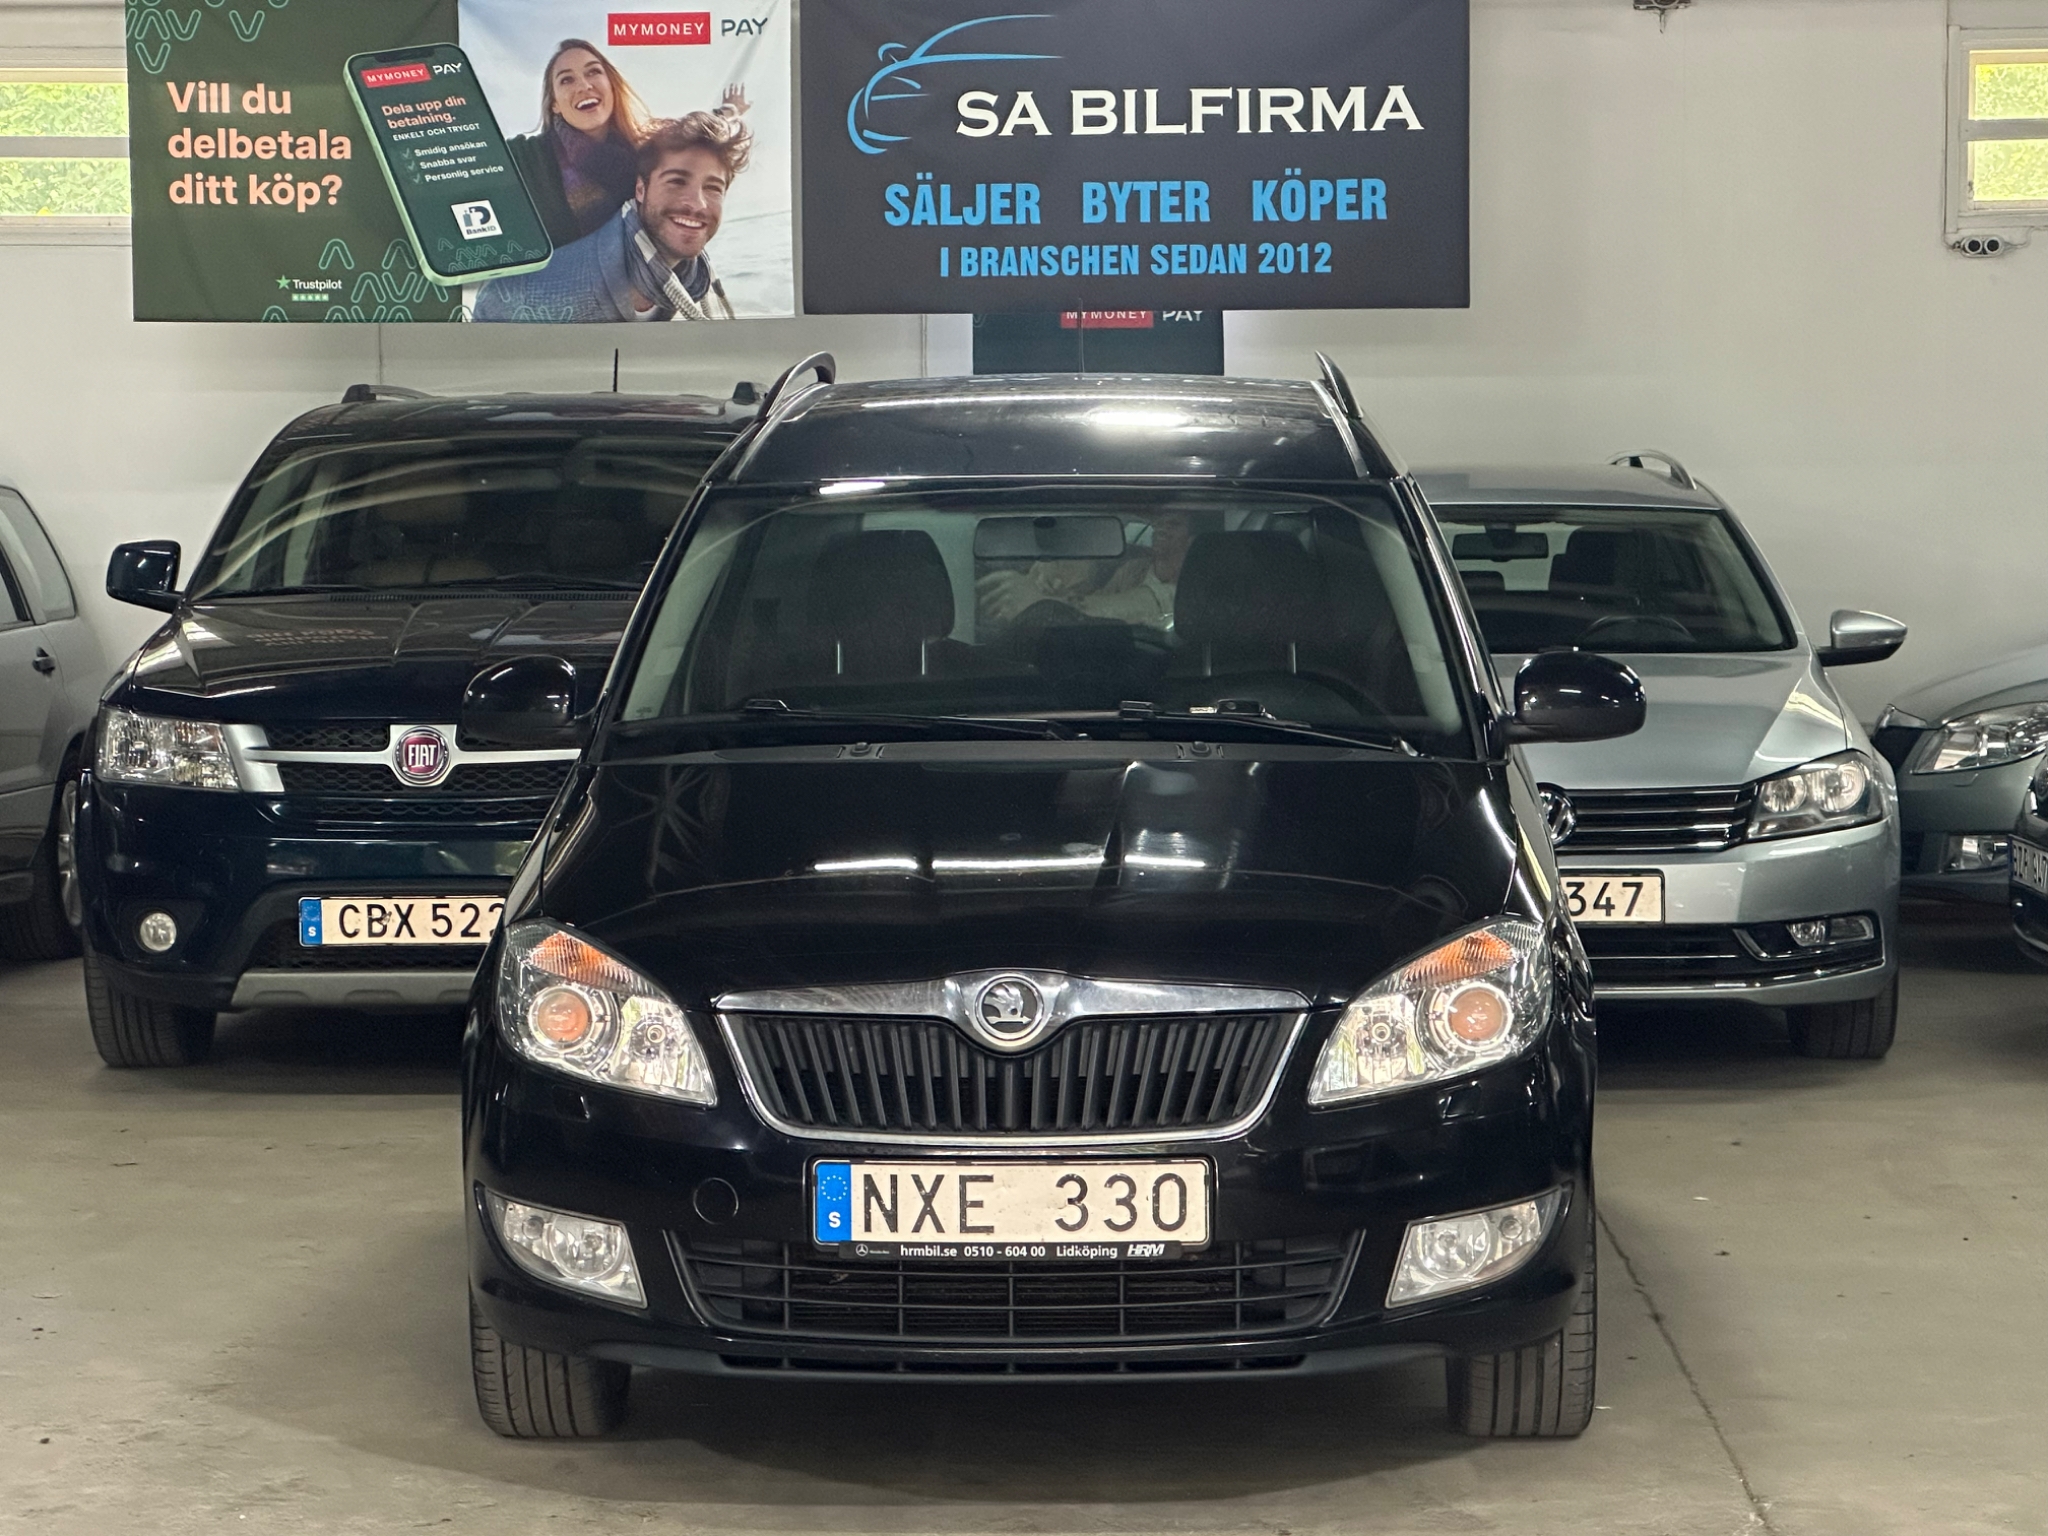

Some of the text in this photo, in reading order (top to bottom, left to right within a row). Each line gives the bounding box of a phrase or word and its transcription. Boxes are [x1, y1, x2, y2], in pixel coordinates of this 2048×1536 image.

[614, 17, 768, 37] MYMONEY PAY
[367, 62, 462, 83] MYMONEY PAY
[168, 82, 290, 113] Vill du
[381, 95, 467, 117] Dela upp din
[387, 111, 456, 129] betalning.
[956, 84, 1425, 138] SA BILFIRMA
[392, 123, 480, 142] ENKELT OCH TRYGGT
[168, 128, 351, 160] delbetala
[414, 140, 488, 158] Smidig ansökan
[420, 155, 477, 170] Snabba svar
[424, 164, 504, 183] Personlig service
[169, 174, 343, 209] ditt köp?
[884, 168, 1387, 226] SÄLJER BYTER KÖPER
[466, 225, 497, 236] BankID
[940, 242, 1332, 278] I BRANSCHEN SEDAN 2012
[292, 279, 342, 291] Trustpilot
[408, 744, 437, 767] FIAT
[1566, 881, 1644, 917] 347
[308, 926, 317, 936] S
[338, 904, 416, 938] CBX
[828, 1173, 1188, 1234] S NXE 330
[900, 1244, 957, 1257] hrmbil.se
[963, 1246, 994, 1257] 0510
[1005, 1245, 1028, 1257] 604
[1030, 1245, 1046, 1257] 00
[1056, 1244, 1118, 1259] Lidköping
[1126, 1243, 1166, 1258] HRM
